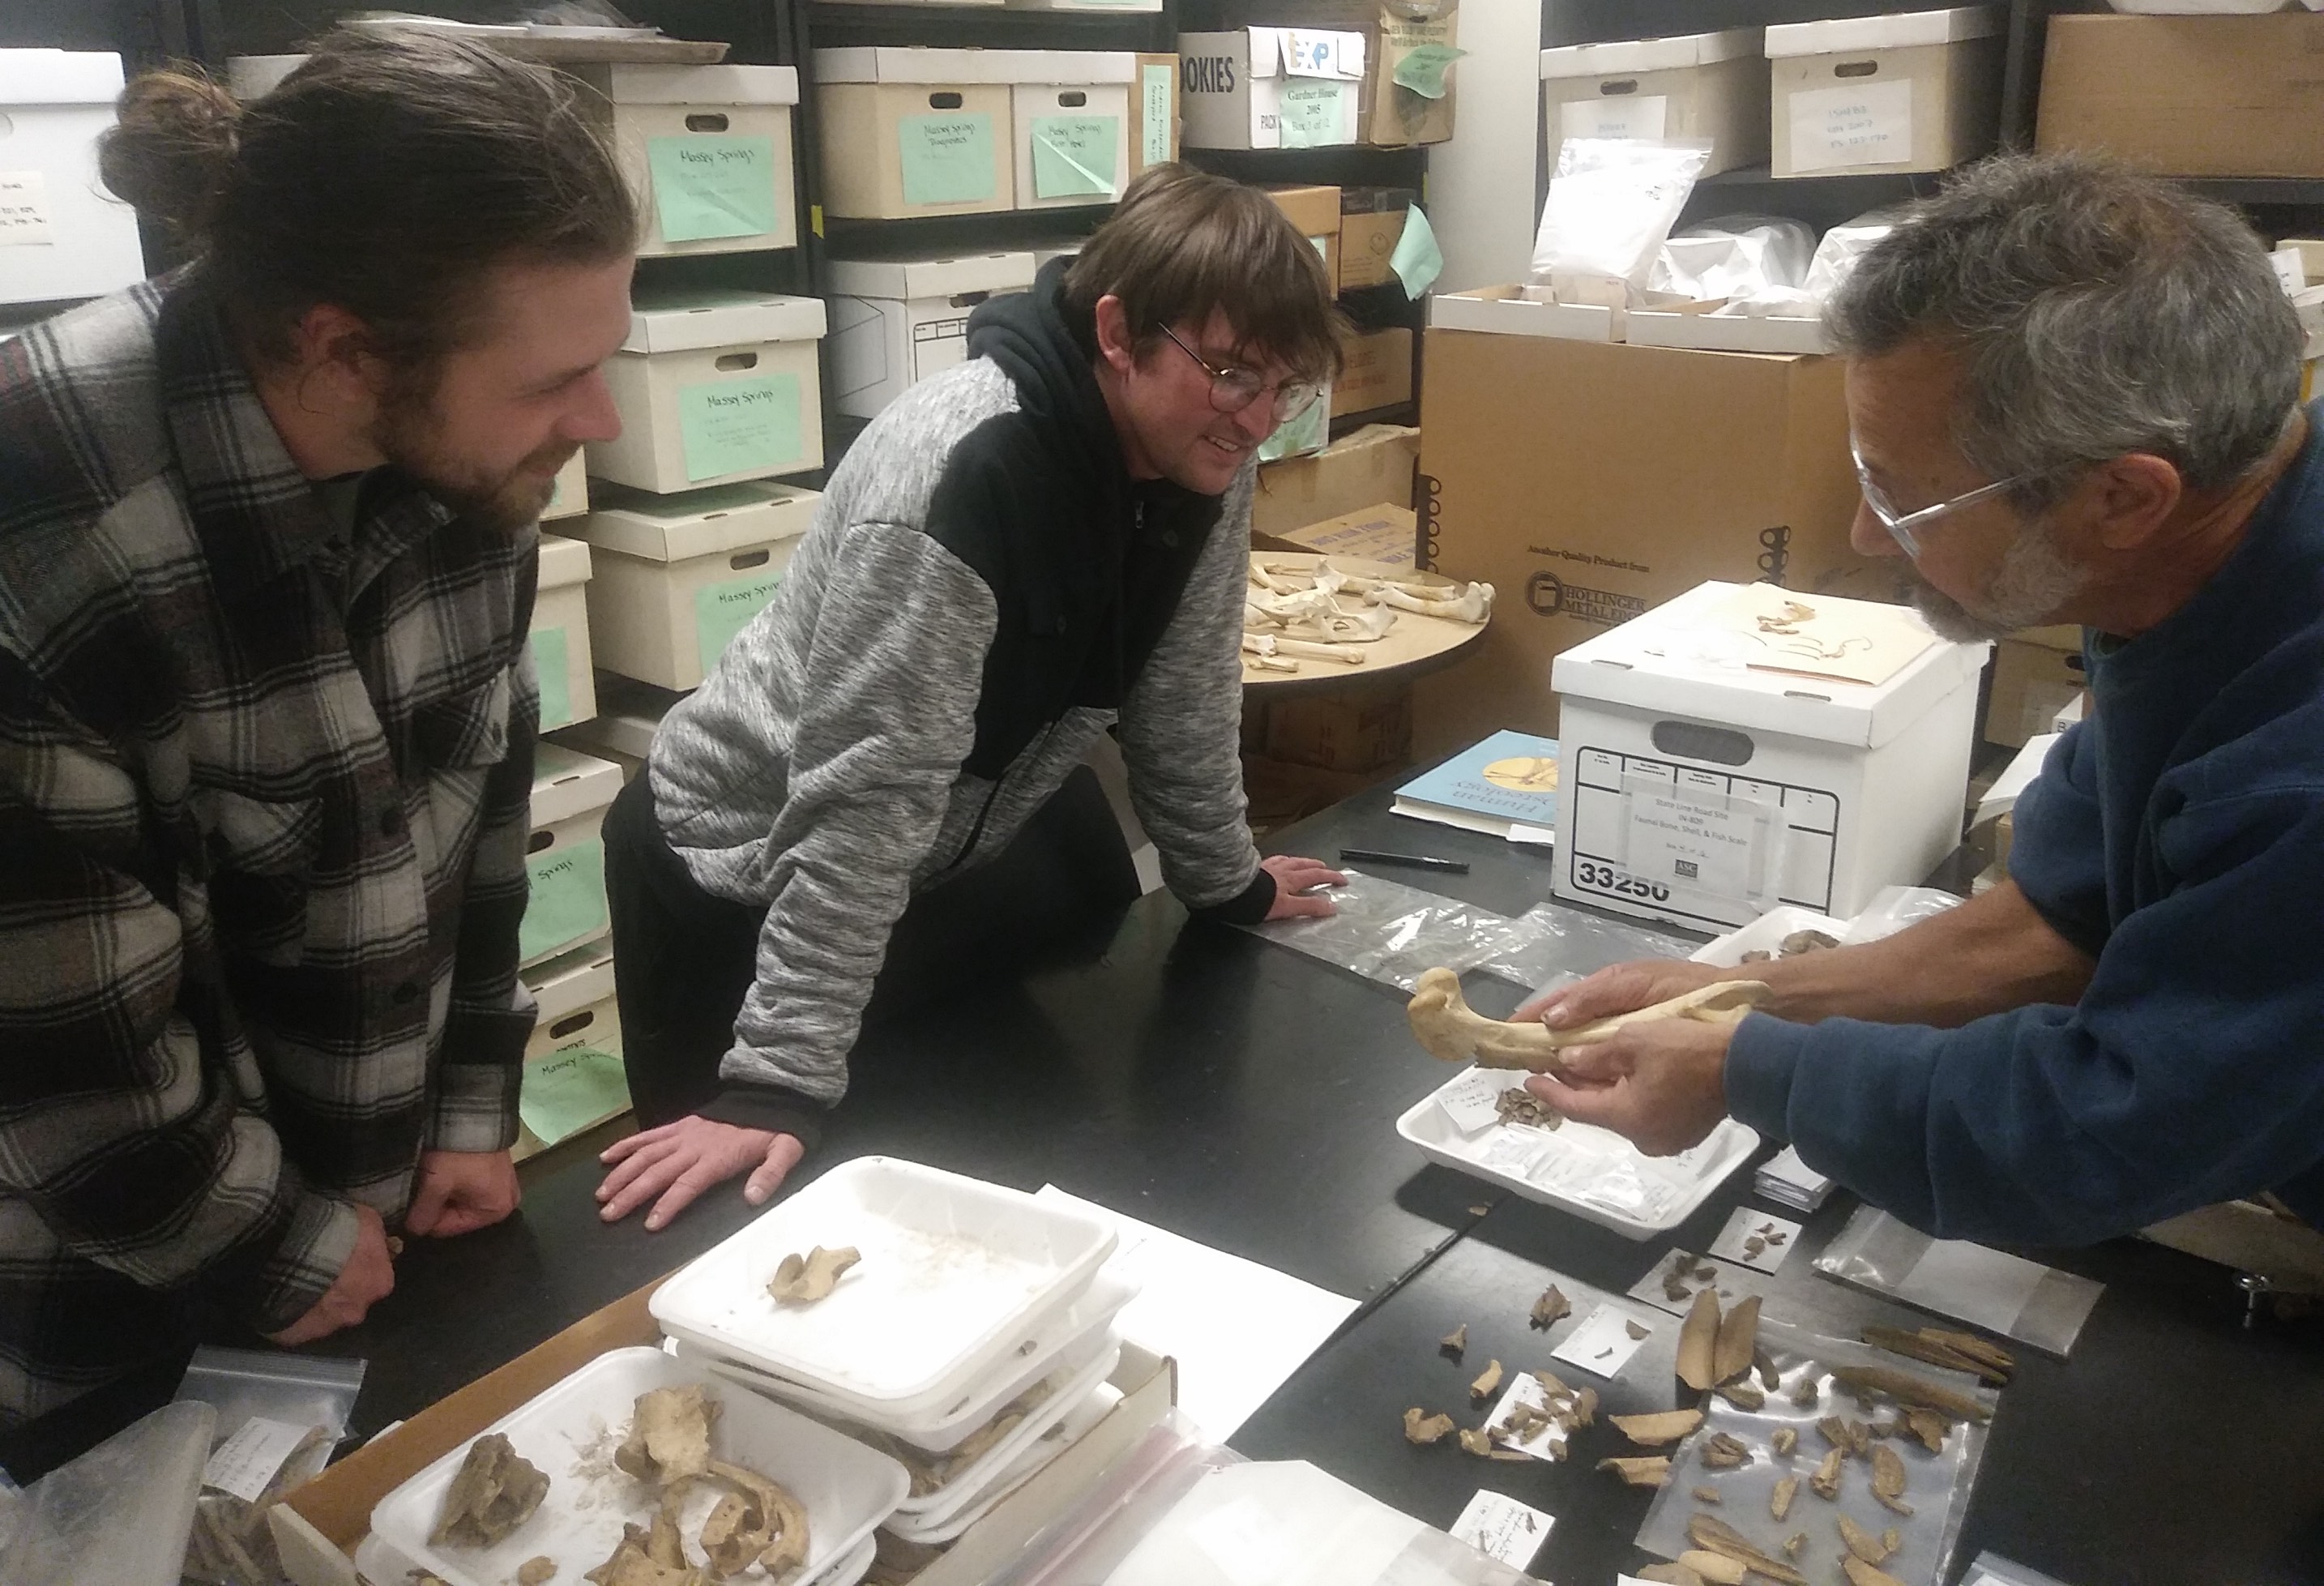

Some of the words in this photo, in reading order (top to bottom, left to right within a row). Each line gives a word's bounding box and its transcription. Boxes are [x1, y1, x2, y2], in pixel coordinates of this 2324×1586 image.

[1288, 89, 1317, 100] Gardner
[1318, 88, 1339, 98] House
[680, 149, 714, 166] Massey
[716, 148, 755, 165] Springs
[707, 394, 741, 408] Massey
[741, 389, 774, 404] Springs
[1527, 545, 1561, 558] Another
[1561, 550, 1591, 564] Quality
[1593, 554, 1627, 570] Product
[1629, 562, 1650, 573] from
[719, 589, 751, 604] Massey
[1566, 587, 1647, 613] HOLLINGER
[1564, 599, 1608, 619] METAL
[1611, 609, 1639, 622] EDG
[1452, 790, 1539, 813] Human
[1655, 797, 1675, 809] State
[1676, 803, 1692, 812] Line
[1694, 806, 1713, 817] Road
[1714, 810, 1729, 821] Site
[1634, 814, 1659, 826] Faunal
[1660, 819, 1680, 832] Bone,
[1681, 824, 1702, 837] Shell,
[1703, 830, 1711, 838] &
[1711, 832, 1727, 842] Fish
[1728, 836, 1748, 847] Scale
[537, 860, 573, 880] Springs
[1678, 861, 1698, 873] ASC
[1579, 862, 1670, 902] 33250
[541, 1057, 577, 1076] Massey
